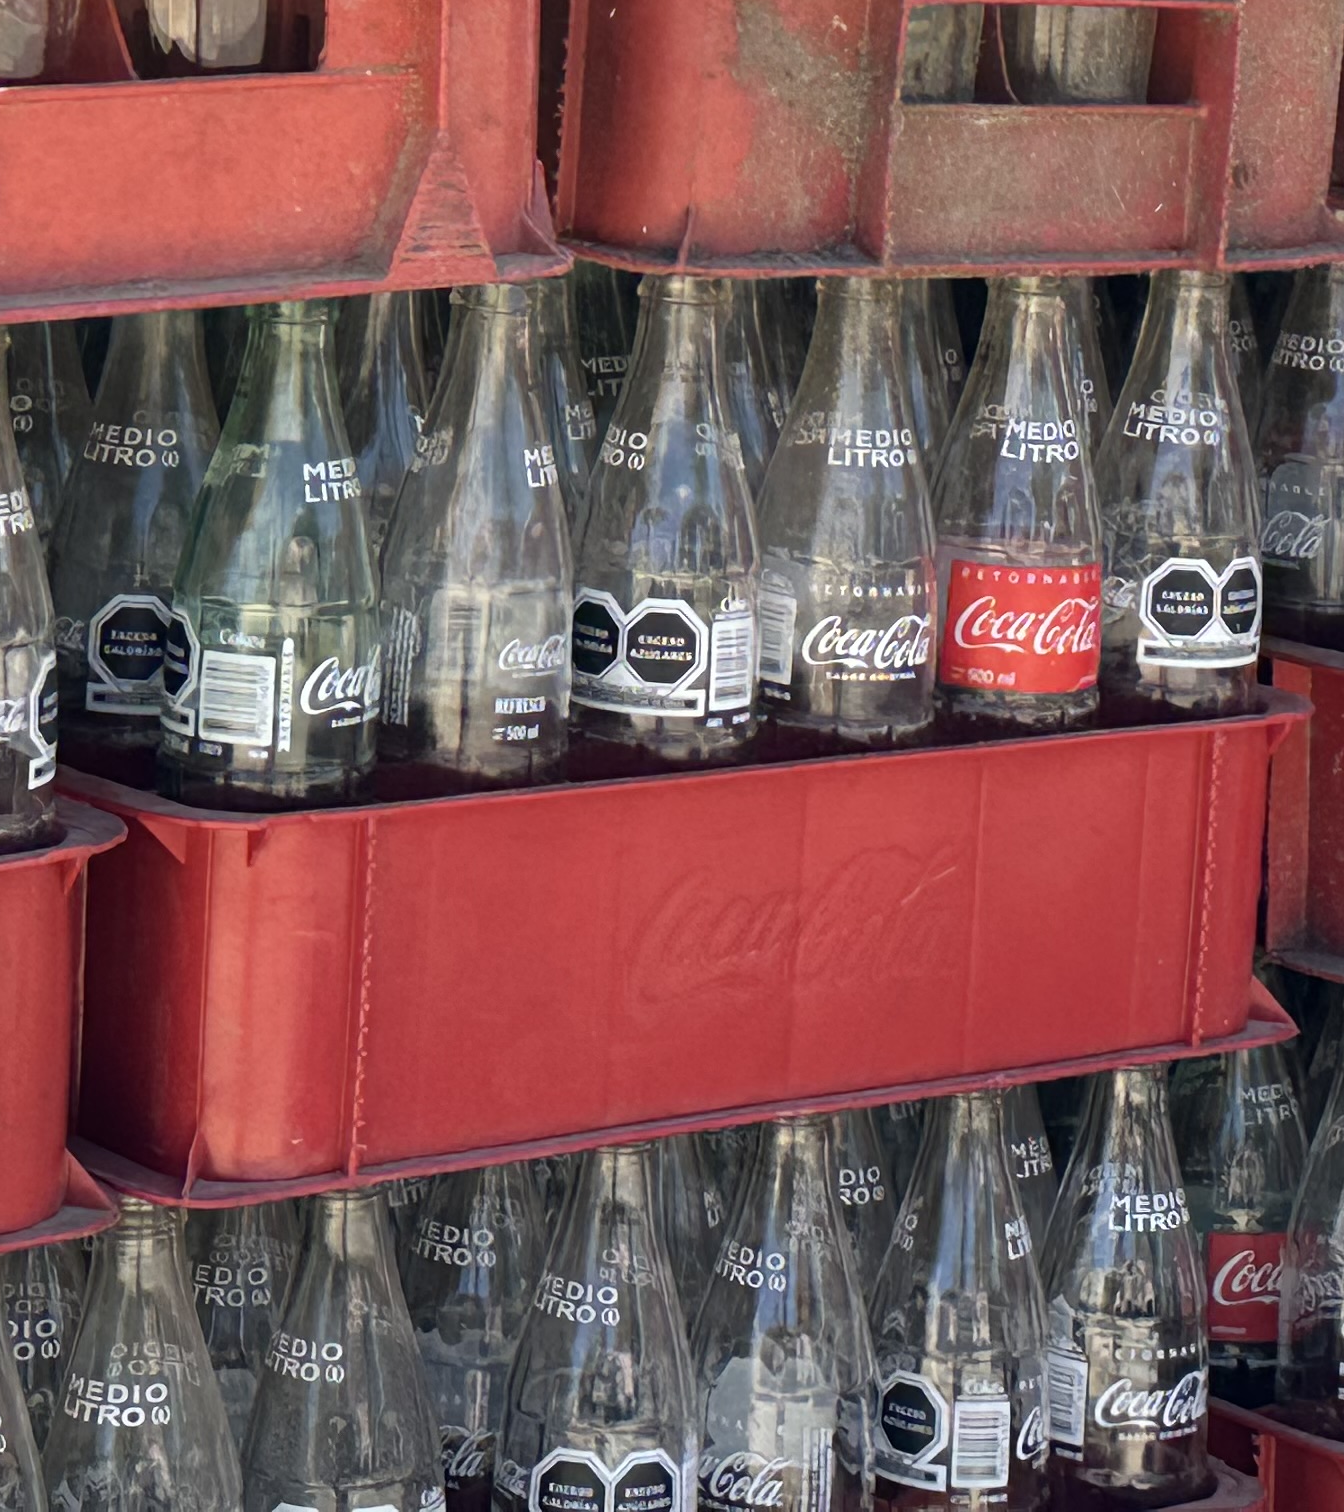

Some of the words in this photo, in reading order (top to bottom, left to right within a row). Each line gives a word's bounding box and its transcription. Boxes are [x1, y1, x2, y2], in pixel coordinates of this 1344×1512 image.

[1128, 400, 1218, 427] MEDIO
[89, 421, 178, 448] MEDIO
[829, 426, 914, 450] MEDIO
[1004, 418, 1077, 442] MEDIO
[827, 448, 904, 468] LITRO
[999, 439, 1080, 464] LITRO
[194, 1263, 269, 1287] EDIO
[69, 1373, 169, 1404] MEDIO
[63, 1397, 149, 1429] LITRO
